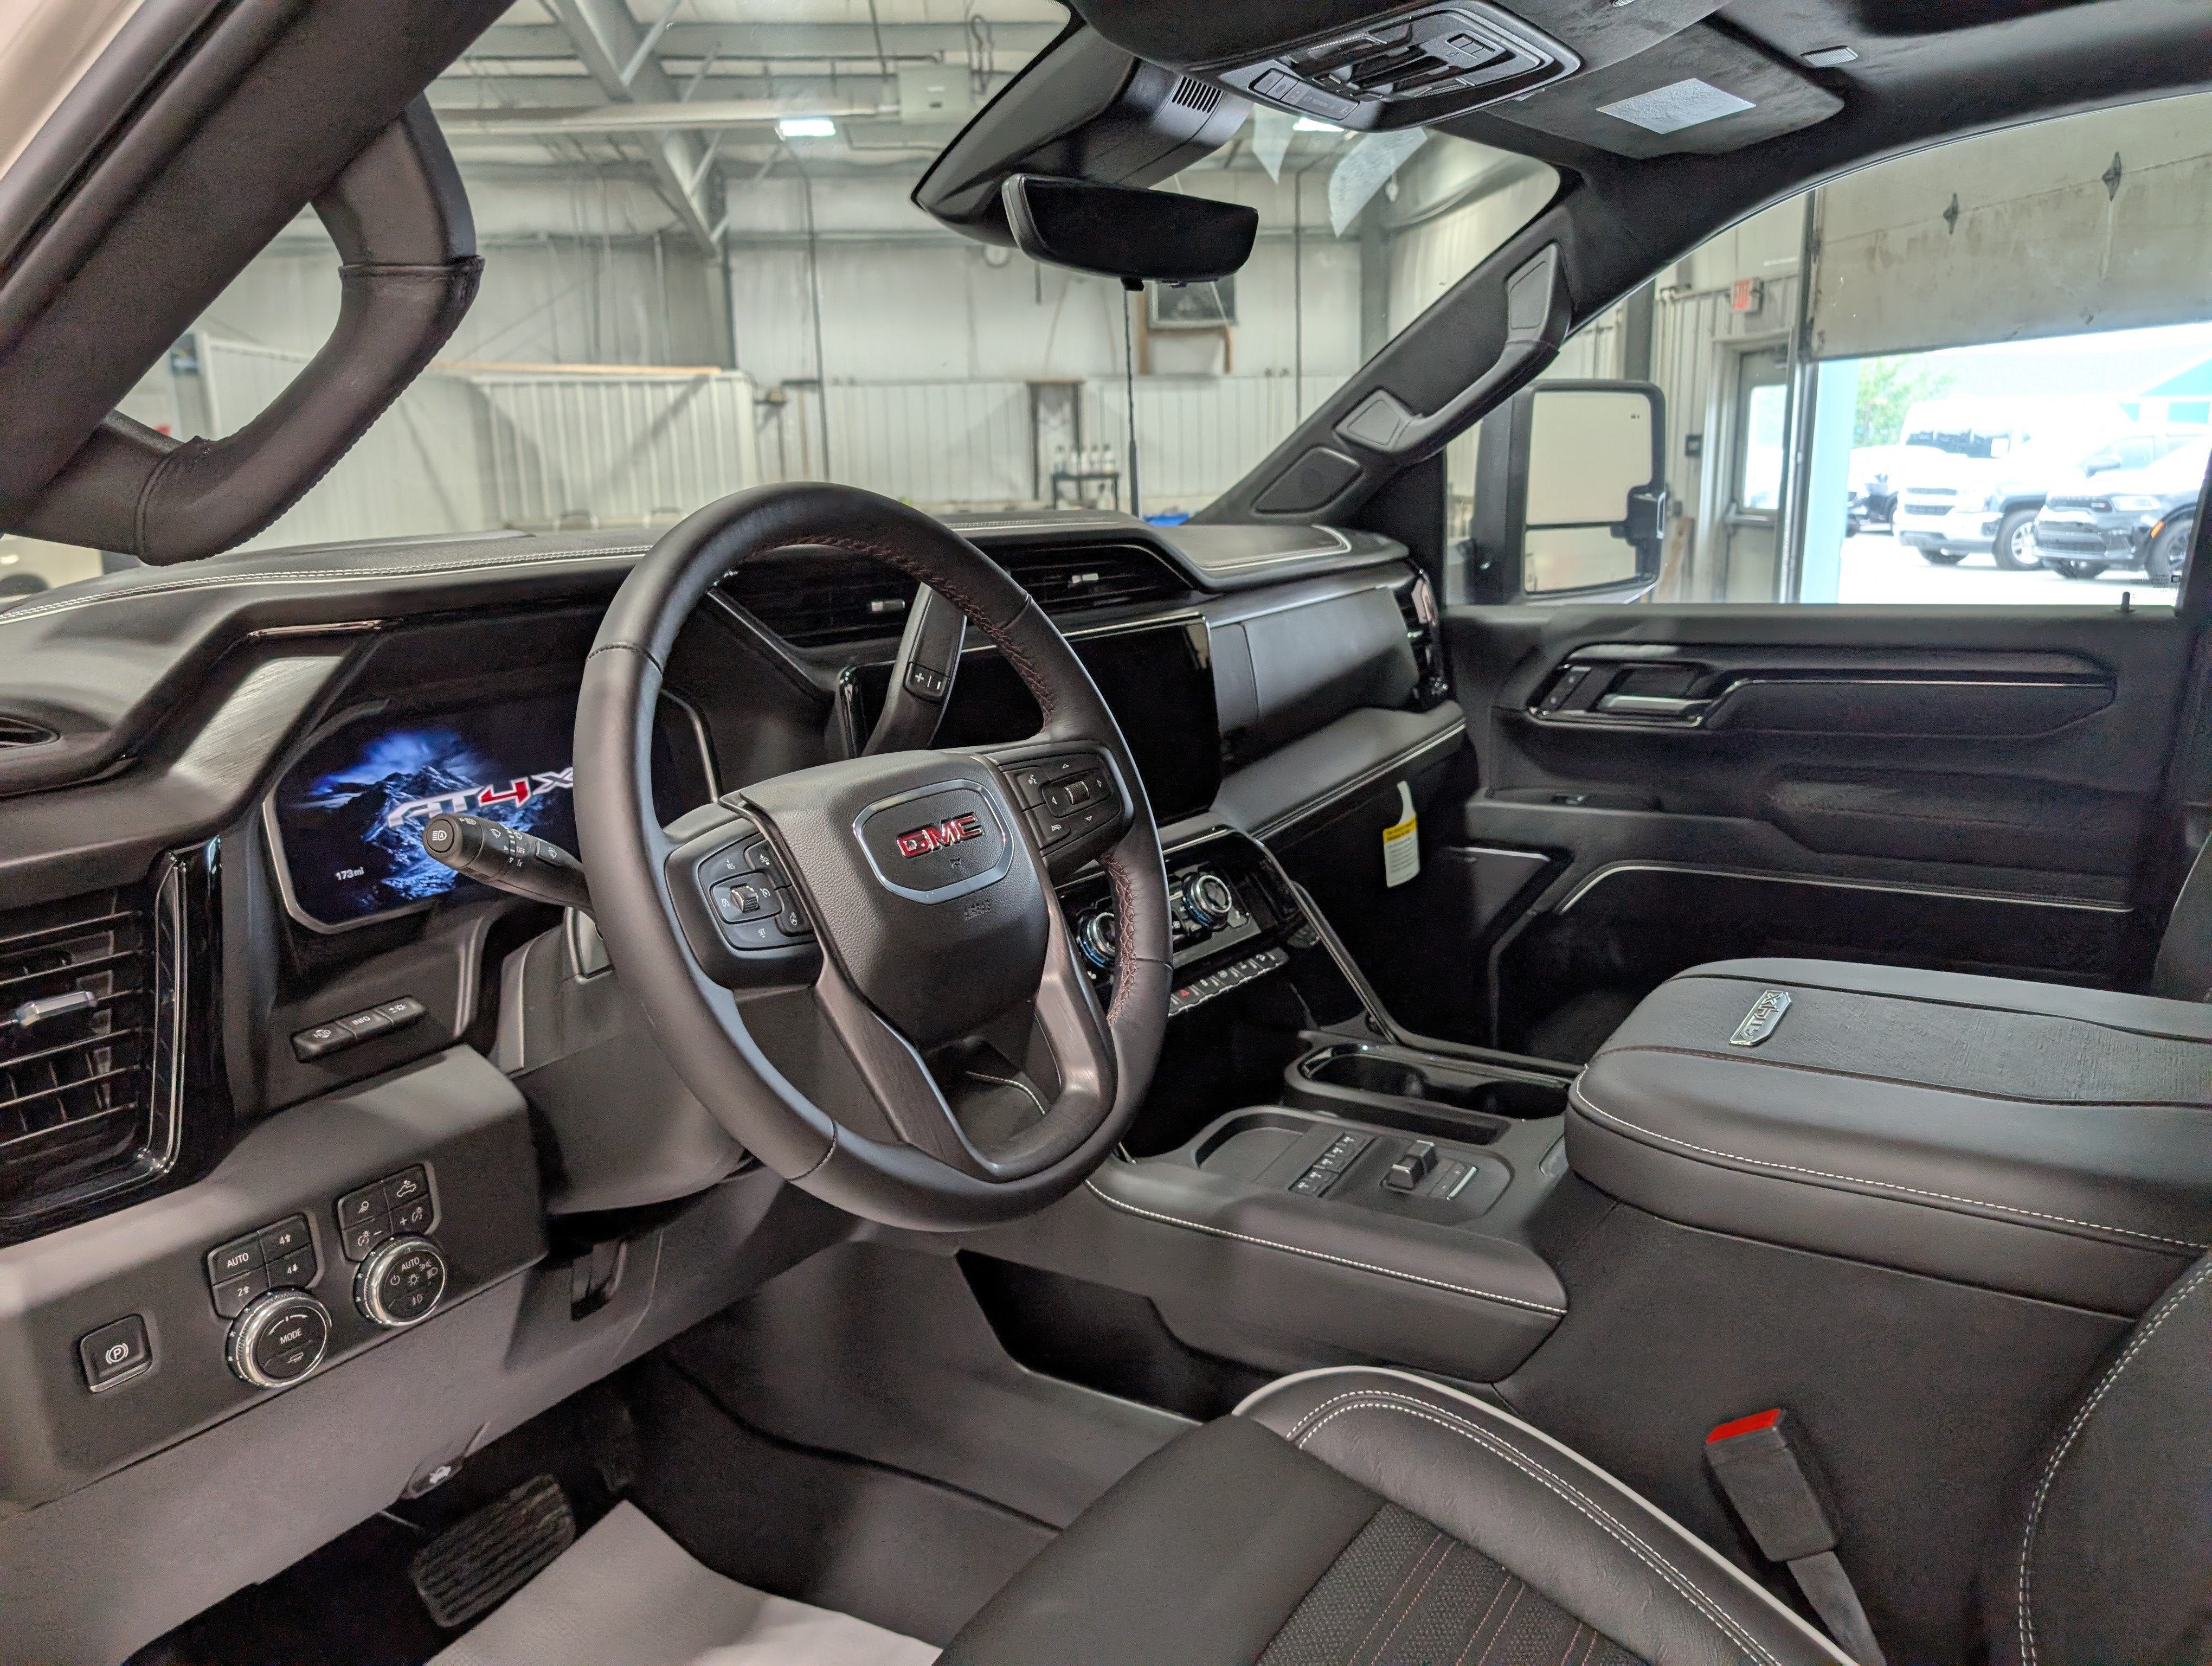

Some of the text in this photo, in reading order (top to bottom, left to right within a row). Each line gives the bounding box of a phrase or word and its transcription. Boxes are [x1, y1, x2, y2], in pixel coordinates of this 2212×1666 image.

[388, 767, 573, 828] AT4X
[896, 812, 985, 858] GMC
[517, 846, 525, 855] OFF
[335, 867, 364, 881] 173mi
[352, 1016, 371, 1026] INFO
[313, 1029, 331, 1039] HUD
[279, 1236, 285, 1245] 4
[227, 1252, 249, 1268] AUTO
[402, 1257, 420, 1272] AUTO
[237, 1288, 244, 1297] 2
[280, 1328, 302, 1344] MODE
[113, 1348, 121, 1360] P
